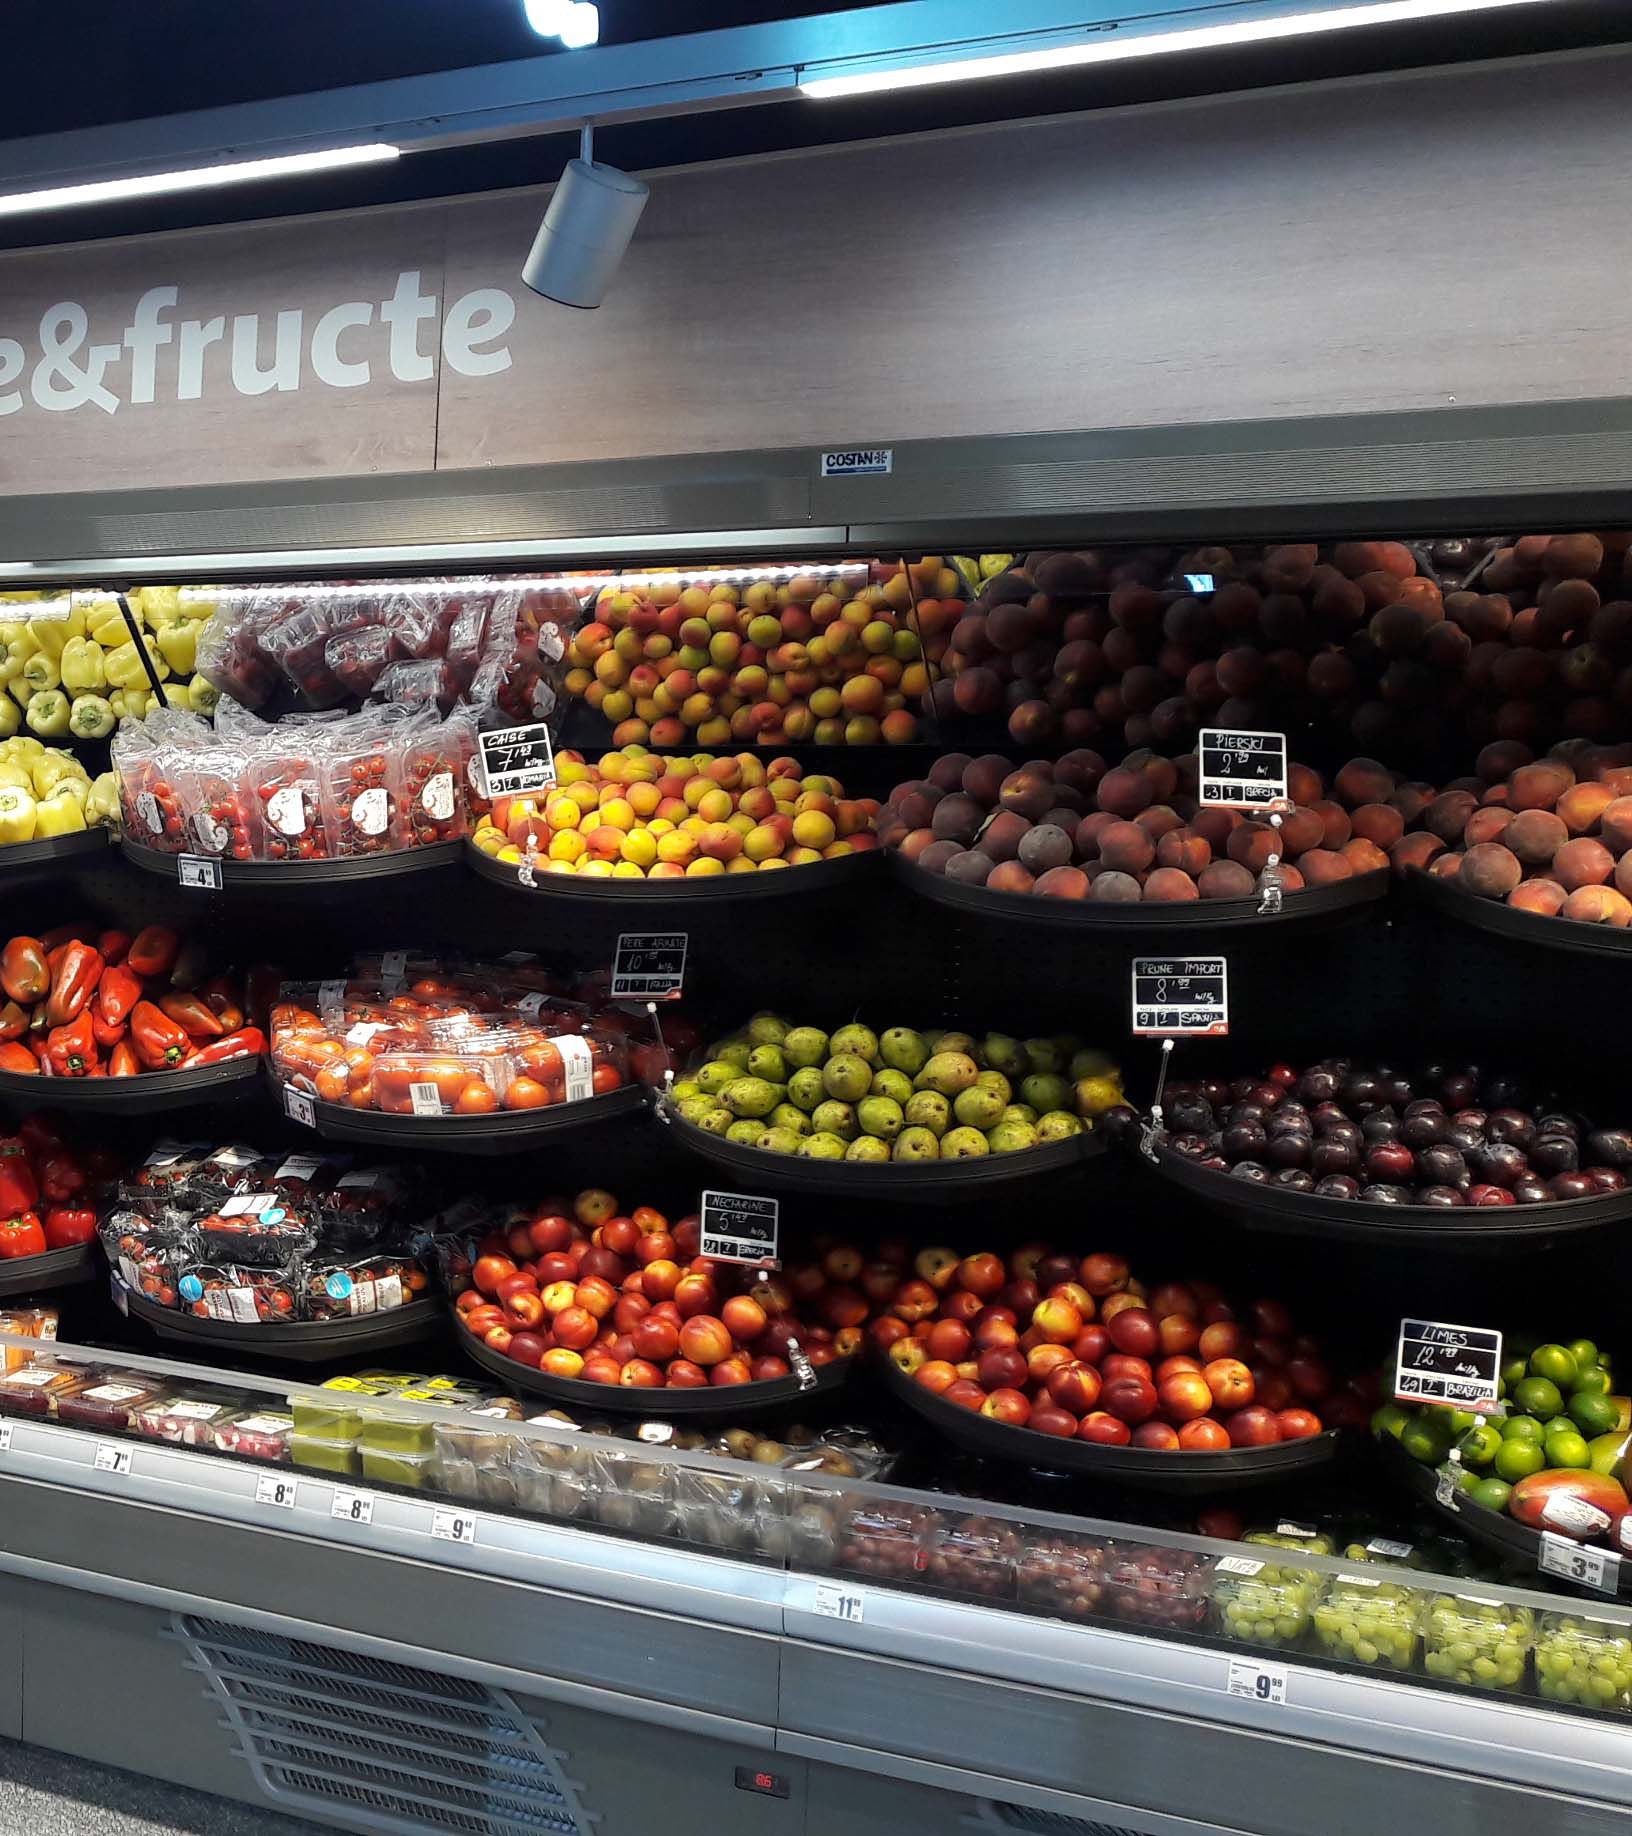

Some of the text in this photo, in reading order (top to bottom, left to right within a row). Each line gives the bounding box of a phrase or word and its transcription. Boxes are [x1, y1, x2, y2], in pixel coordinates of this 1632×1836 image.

[826, 452, 874, 467] COSTAN
[488, 731, 527, 746] CAISE
[1141, 962, 1223, 975] PRUNE IMPORT
[1420, 1326, 1467, 1346] LIMES
[275, 1484, 285, 1503] 8
[351, 1500, 361, 1519] 8
[452, 1519, 464, 1539] 9
[1571, 1556, 1586, 1578] 3
[838, 1596, 853, 1618] 11
[1256, 1675, 1271, 1699] 9
